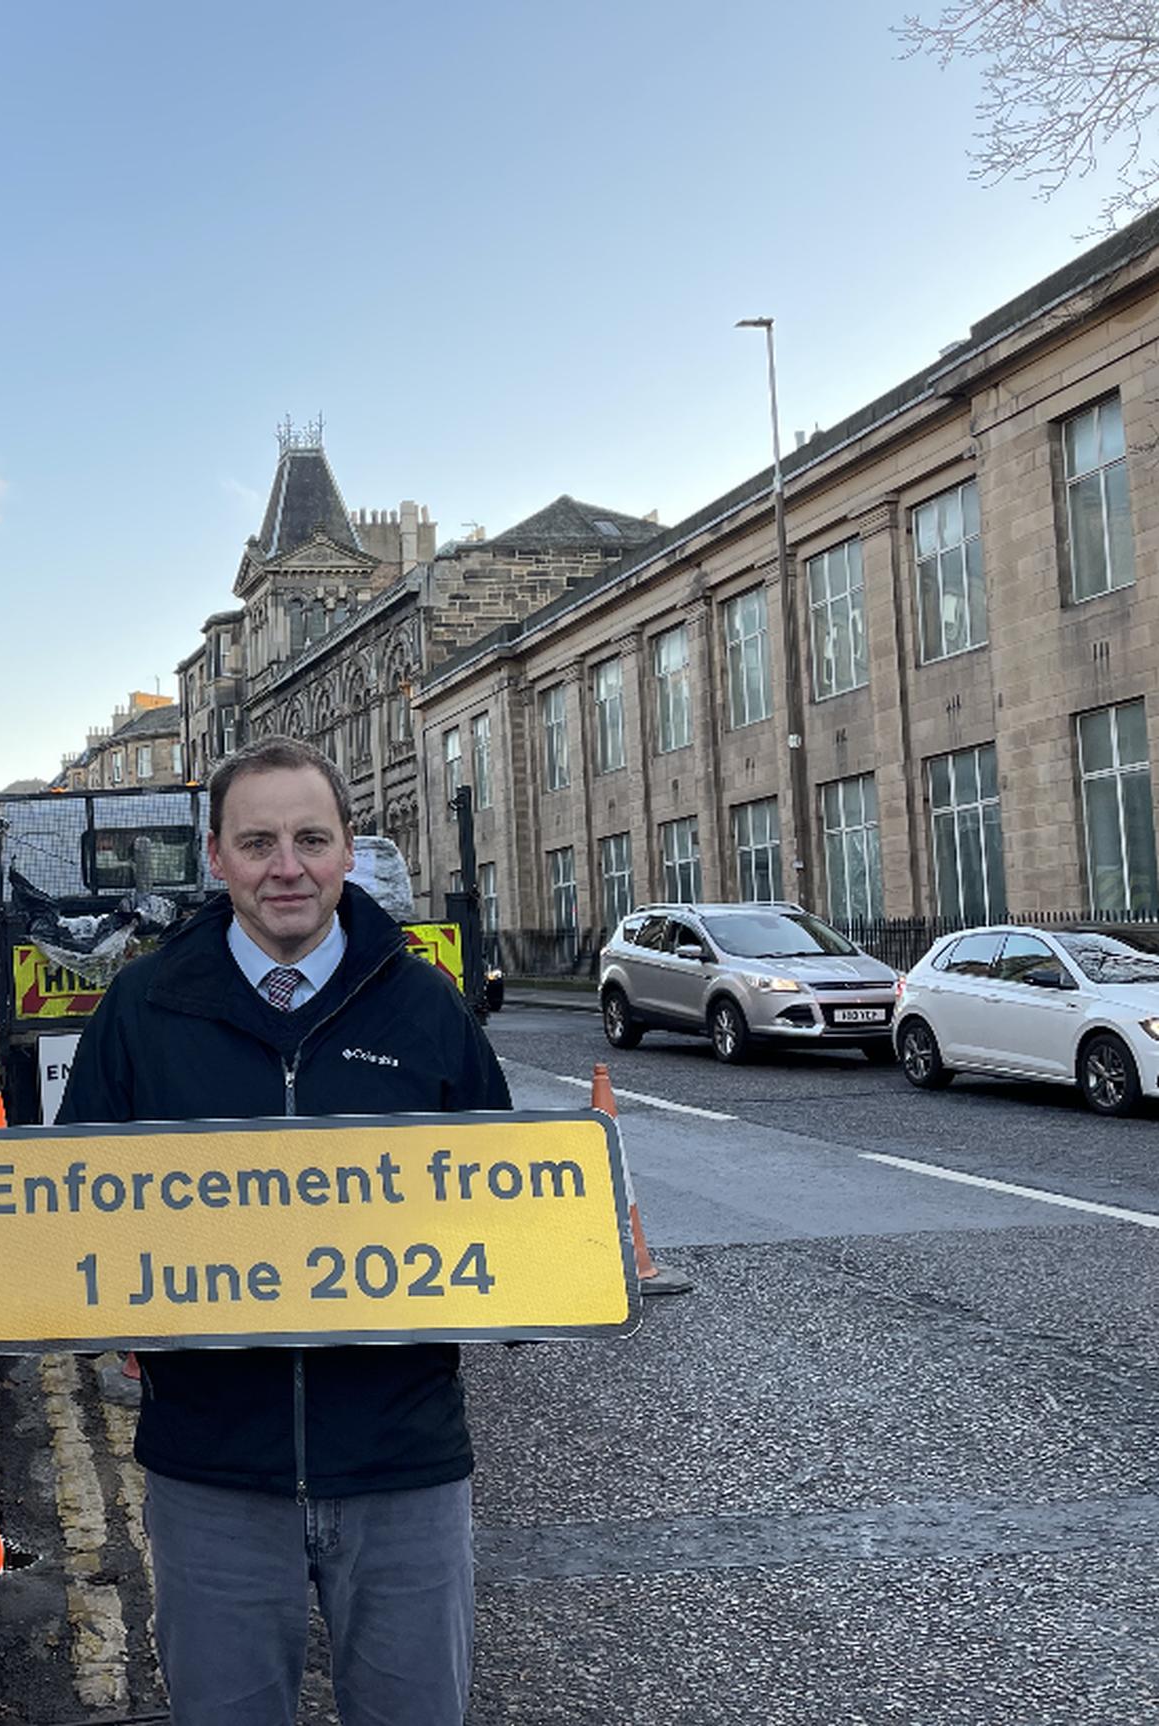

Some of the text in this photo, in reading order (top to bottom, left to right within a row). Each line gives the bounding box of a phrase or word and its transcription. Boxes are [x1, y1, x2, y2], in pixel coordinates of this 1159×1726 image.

[428, 1150, 586, 1202] from
[76, 1242, 496, 1306] 1 June 2024
